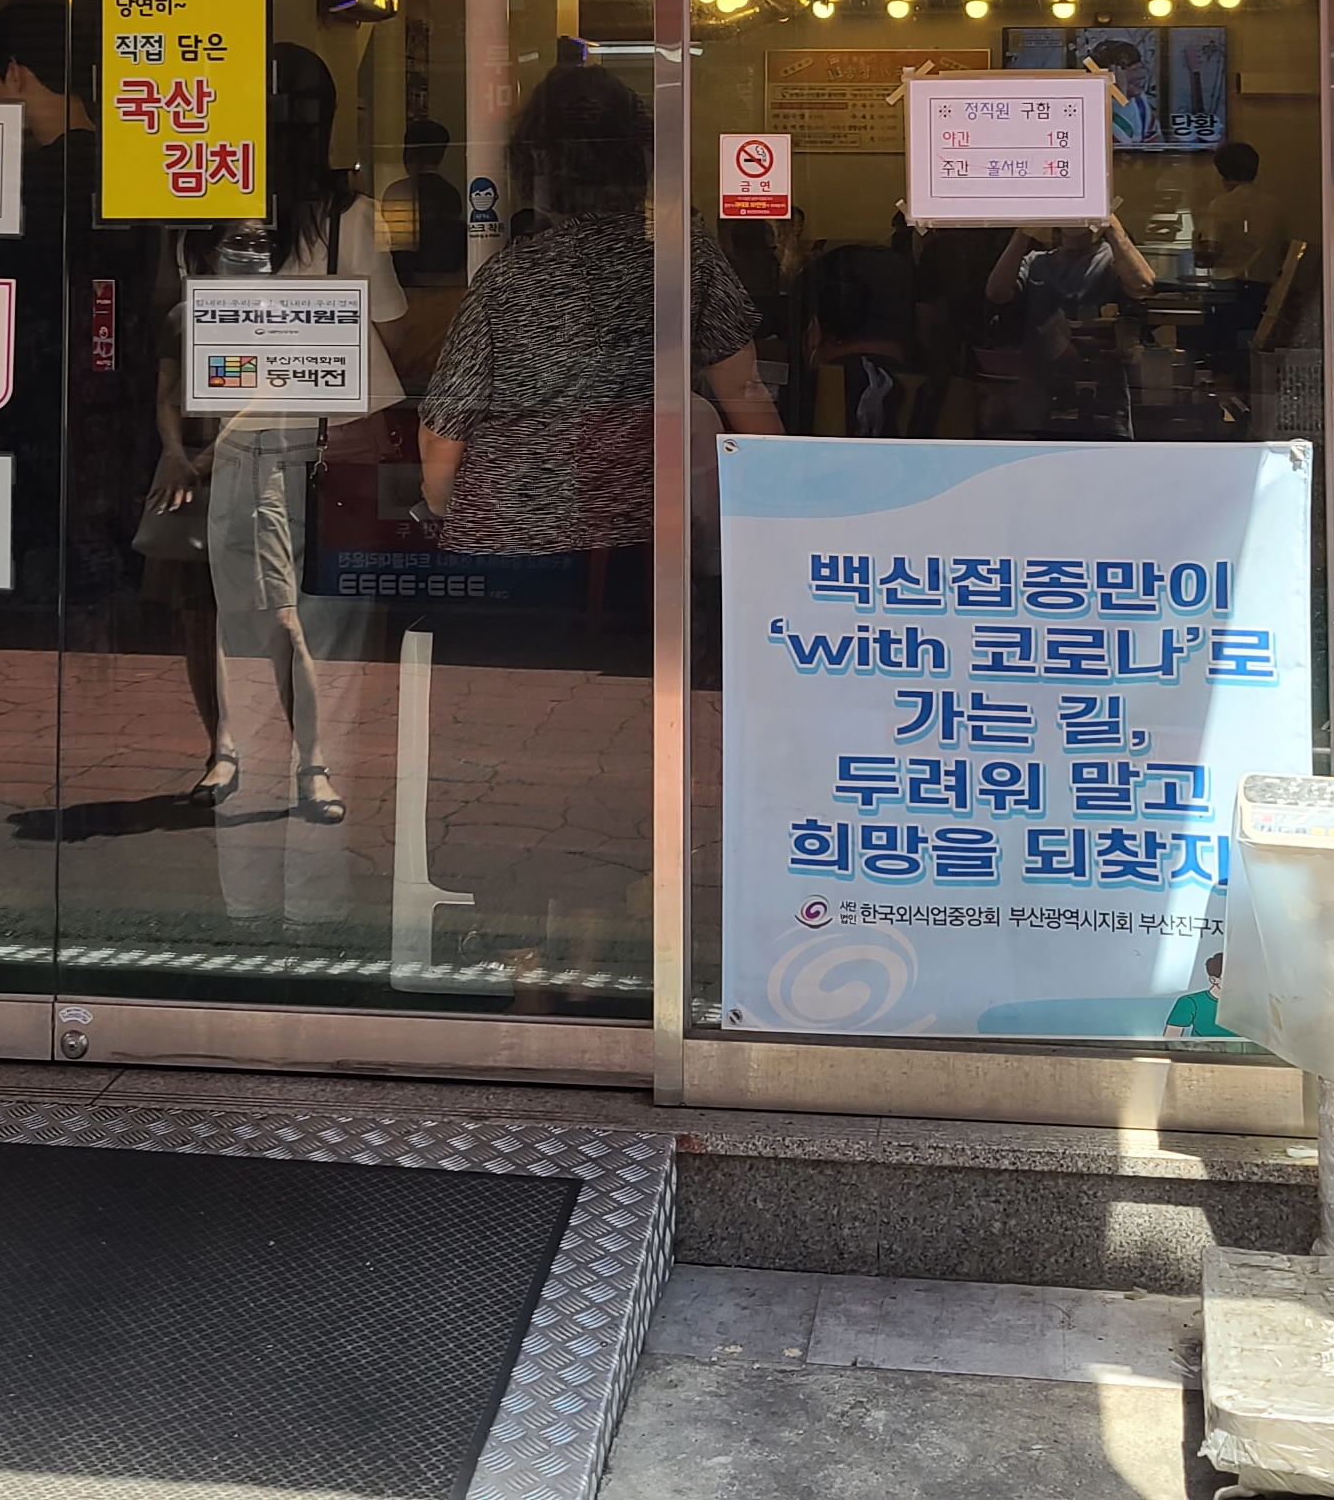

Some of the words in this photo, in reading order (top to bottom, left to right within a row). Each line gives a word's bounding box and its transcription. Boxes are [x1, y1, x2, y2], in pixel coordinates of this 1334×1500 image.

[115, 33, 164, 64] 직접
[177, 33, 229, 62] 담은
[114, 77, 216, 133] 국산
[964, 100, 1011, 121] 정직원
[1019, 101, 1052, 121] 구함
[942, 130, 971, 148] 야간
[1170, 112, 1219, 138] 당황
[162, 140, 255, 197] 김치
[941, 159, 969, 177] 주간
[986, 159, 1030, 178] 홀서빙
[193, 308, 361, 325] 긴급재난지원금
[265, 368, 347, 388] 동백전
[808, 551, 1233, 615] 백신접종만이
[894, 689, 1036, 749] 가는
[1058, 693, 1151, 752] 길,
[833, 754, 1045, 816] 두려워
[1070, 759, 1213, 817] 말고
[787, 816, 1000, 884] 희망을
[859, 902, 1001, 928] 한국외식업중앙회
[1007, 906, 1134, 935] 부산광역시지회
